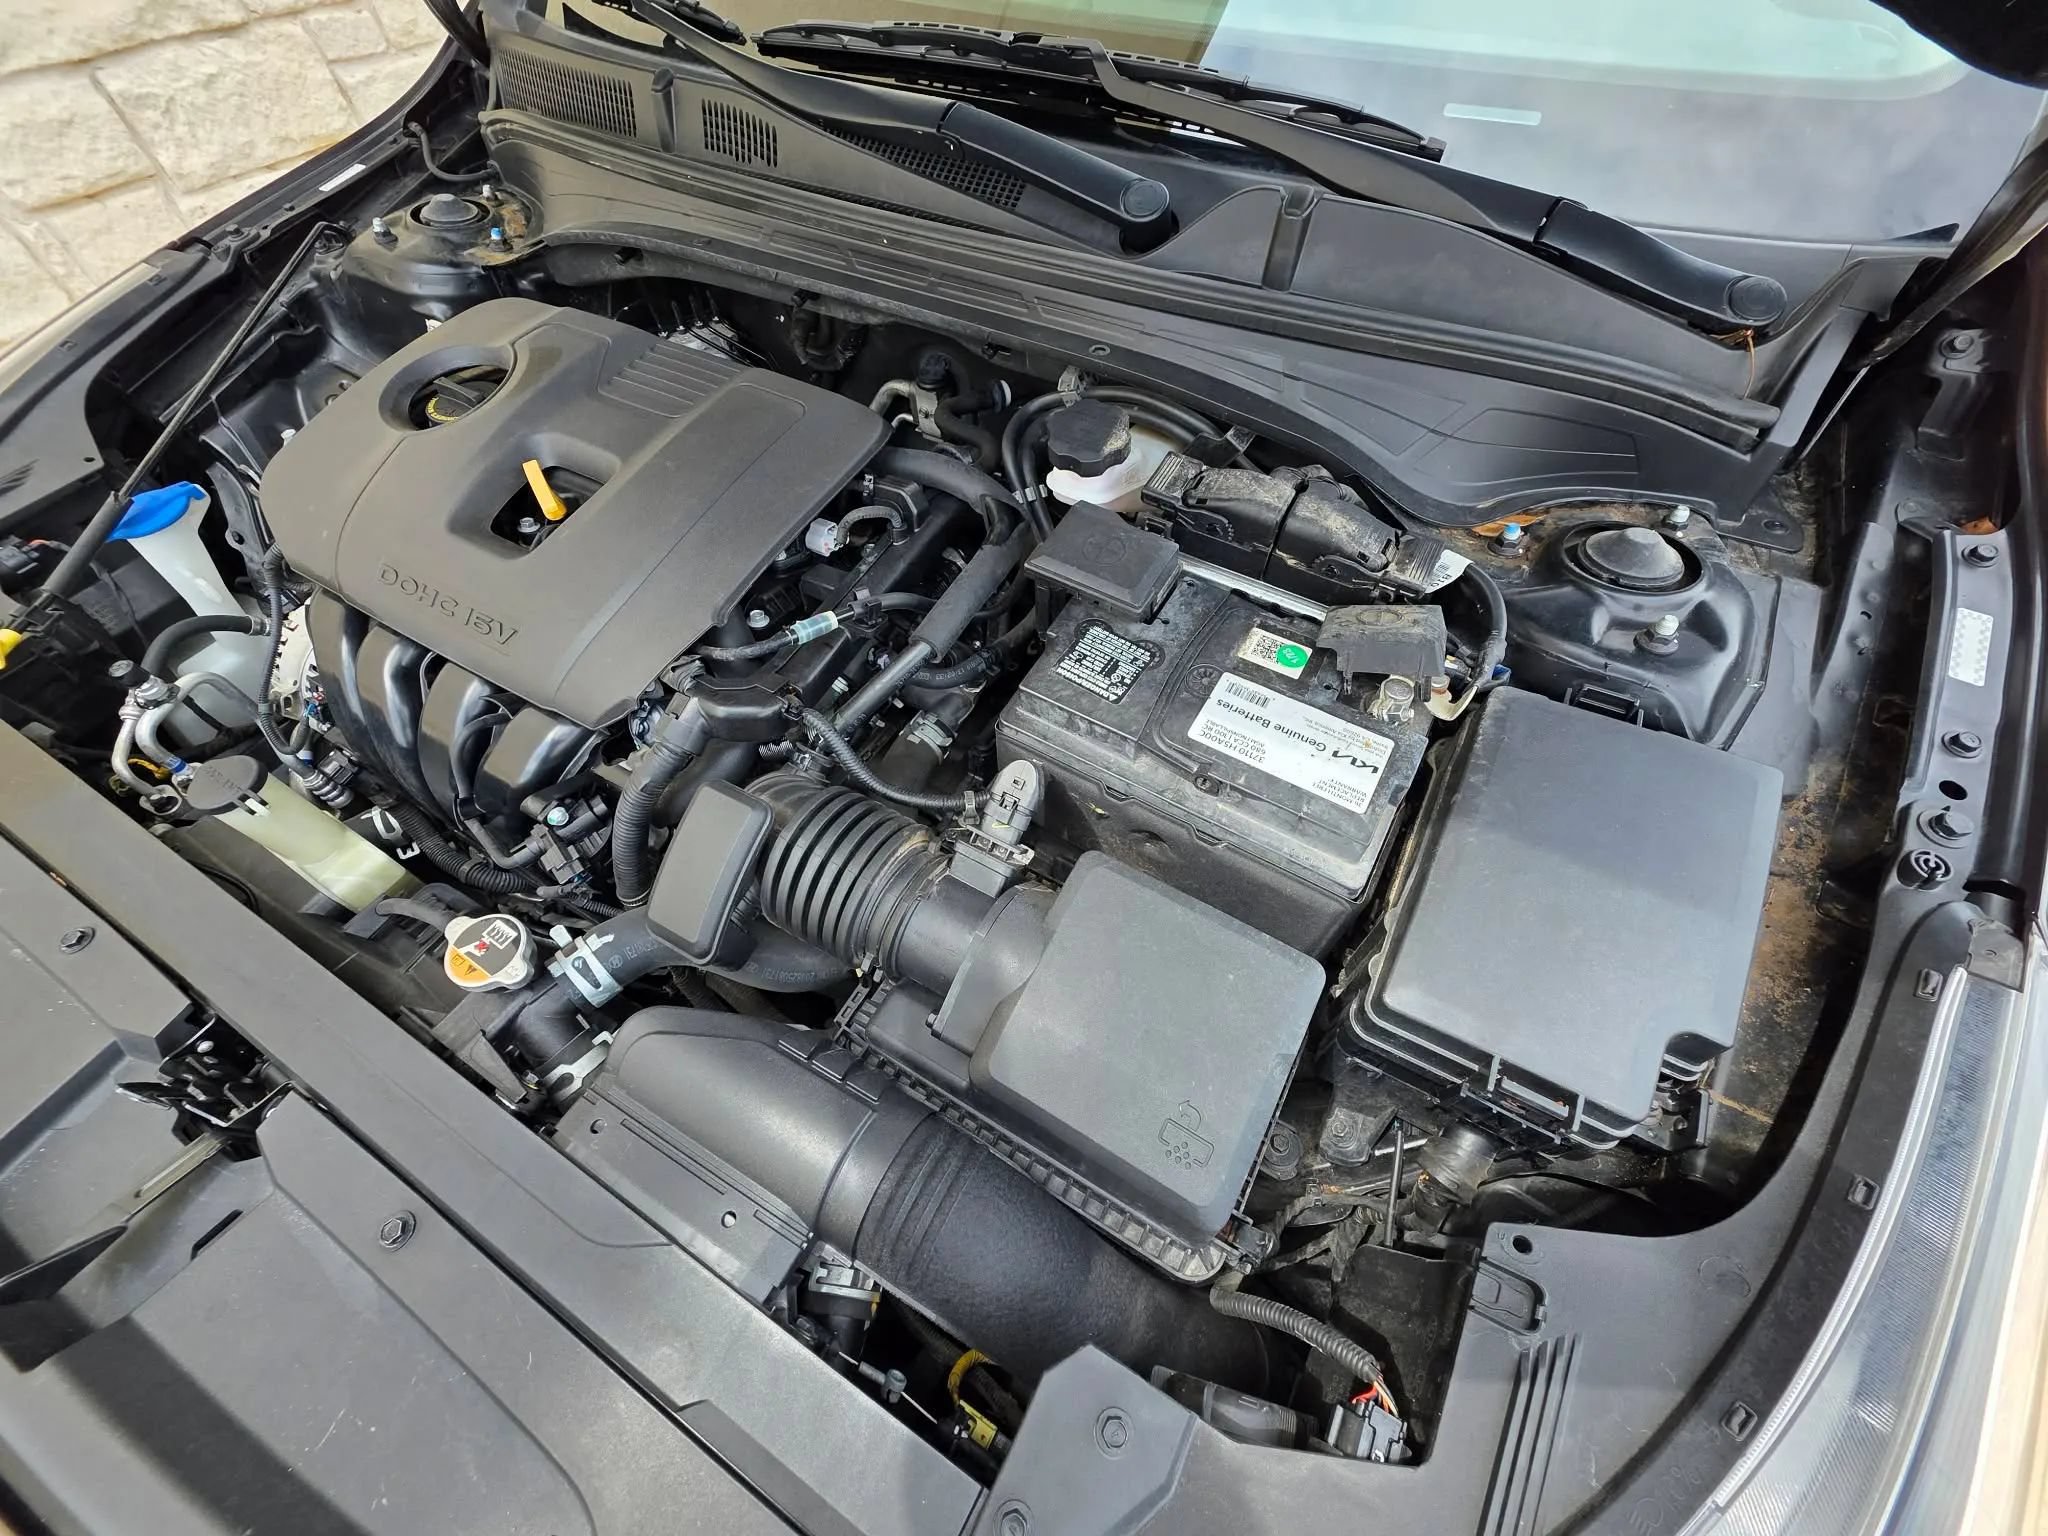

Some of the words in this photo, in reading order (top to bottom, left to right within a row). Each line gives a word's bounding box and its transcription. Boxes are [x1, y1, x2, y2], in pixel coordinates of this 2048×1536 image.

[375, 562, 461, 618] DOHC
[1214, 697, 1271, 729] Batteries
[1201, 723, 1214, 732] RC
[1271, 722, 1327, 753] Genuine
[1231, 736, 1250, 748] CCA
[1237, 746, 1265, 764] 37110
[1331, 748, 1379, 775] KIA
